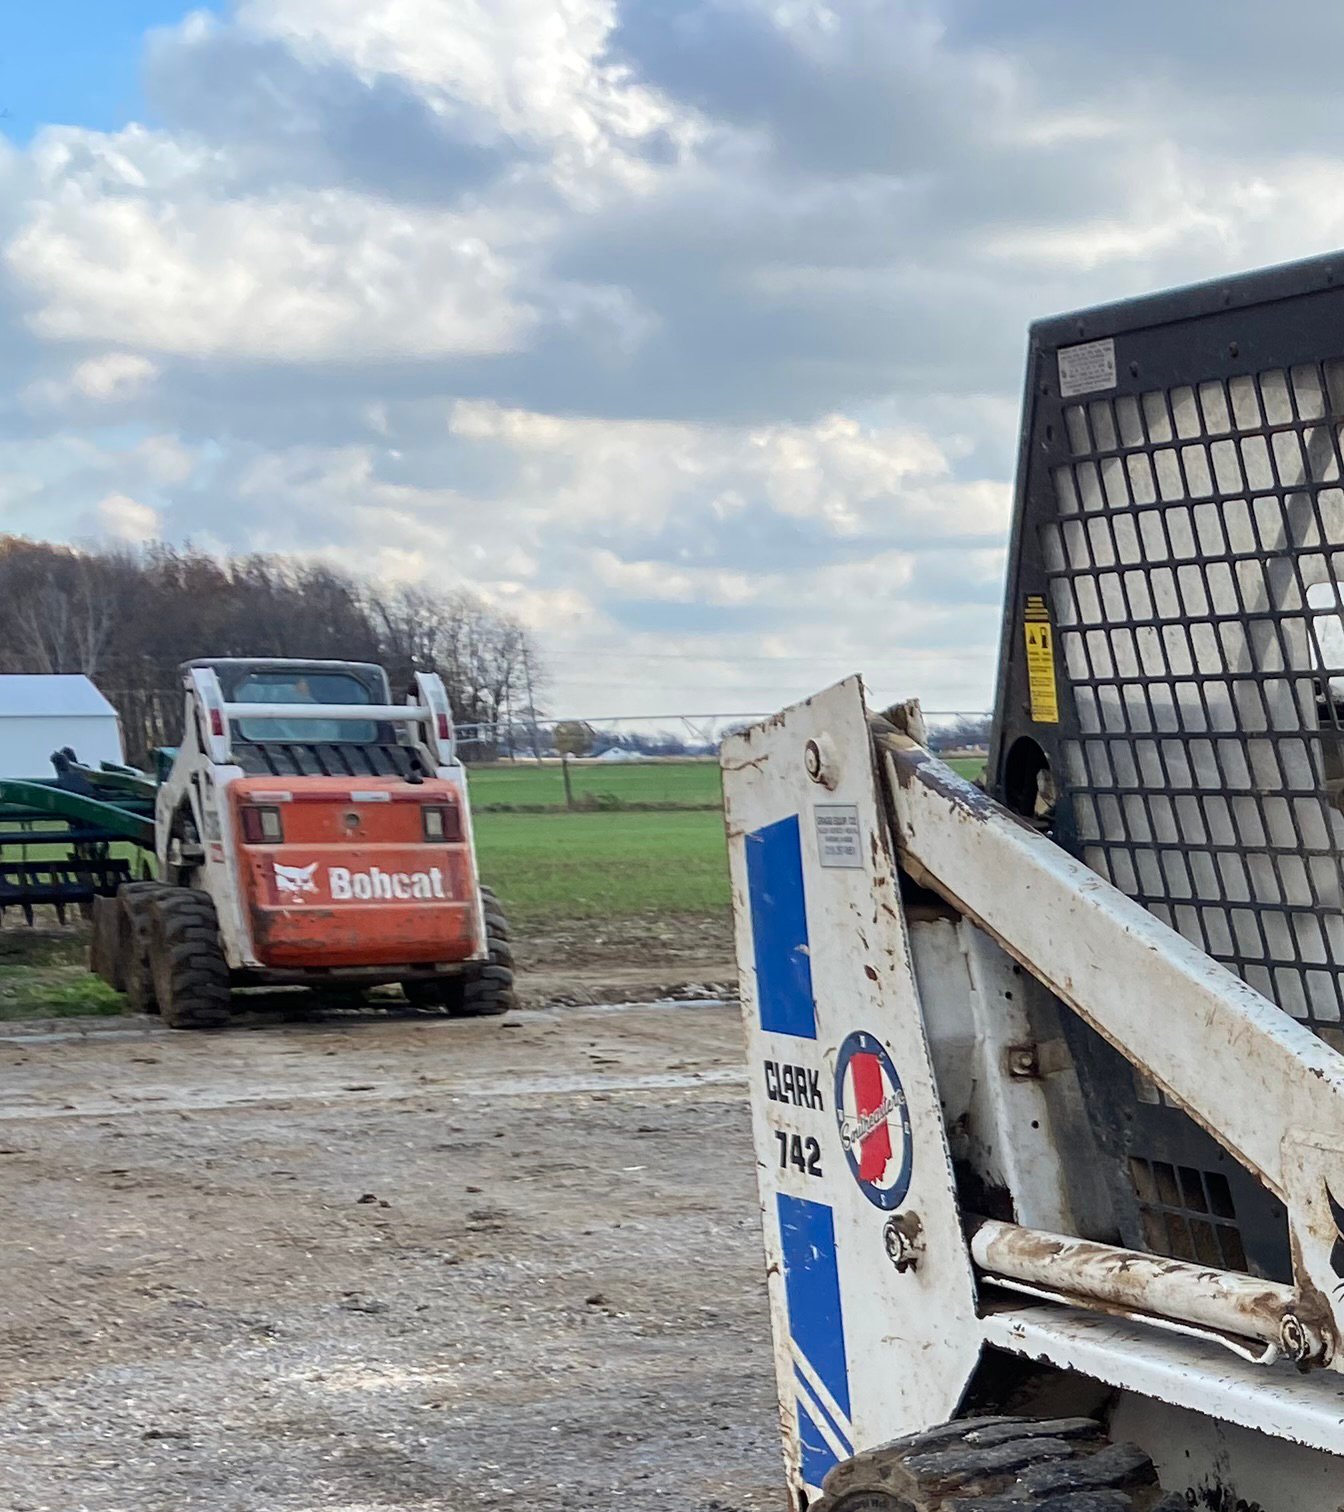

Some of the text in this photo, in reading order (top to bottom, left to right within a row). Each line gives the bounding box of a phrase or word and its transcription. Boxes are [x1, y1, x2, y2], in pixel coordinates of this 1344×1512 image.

[328, 866, 446, 899] Bobcat
[763, 1060, 825, 1111] CLARK
[774, 1130, 823, 1177] 742
